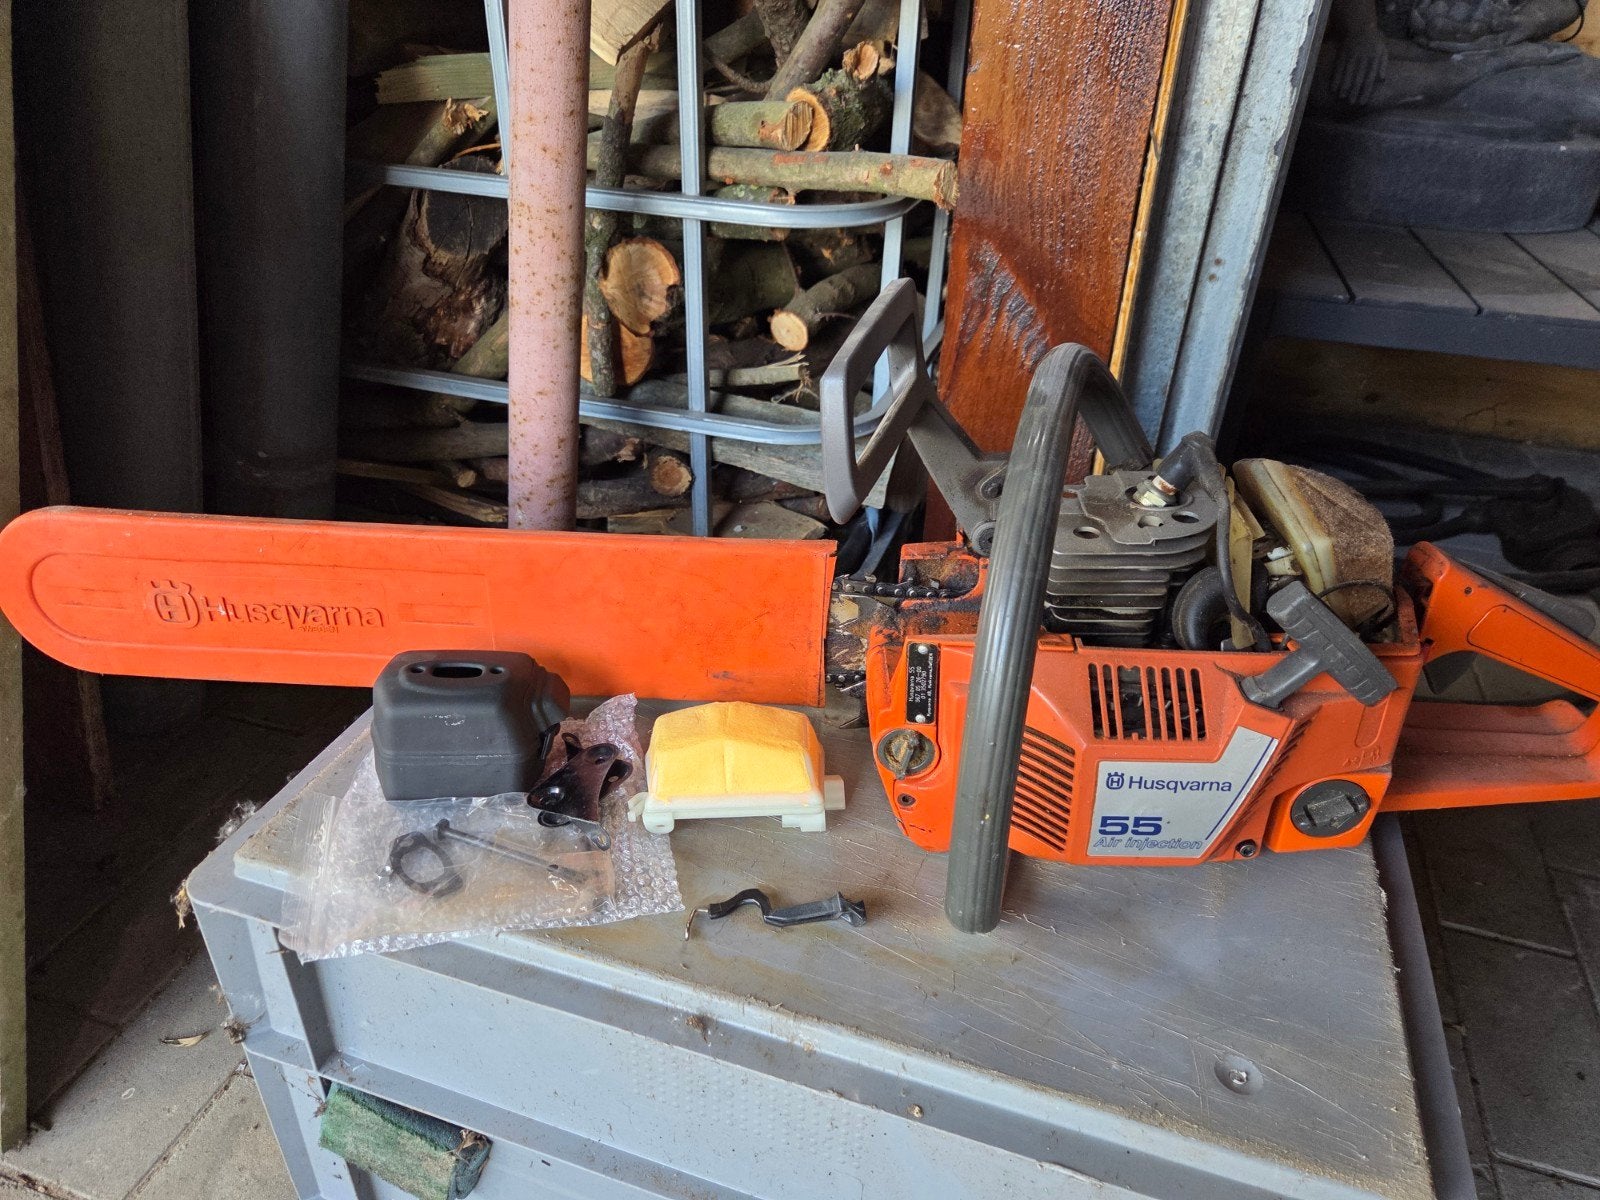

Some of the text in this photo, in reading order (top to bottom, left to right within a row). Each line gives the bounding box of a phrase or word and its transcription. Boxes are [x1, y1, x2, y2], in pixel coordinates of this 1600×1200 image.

[201, 596, 385, 630] Husqvarna
[1128, 776, 1233, 793] Husqvarna
[1098, 816, 1163, 836] 55
[1093, 837, 1203, 851] Air injection
